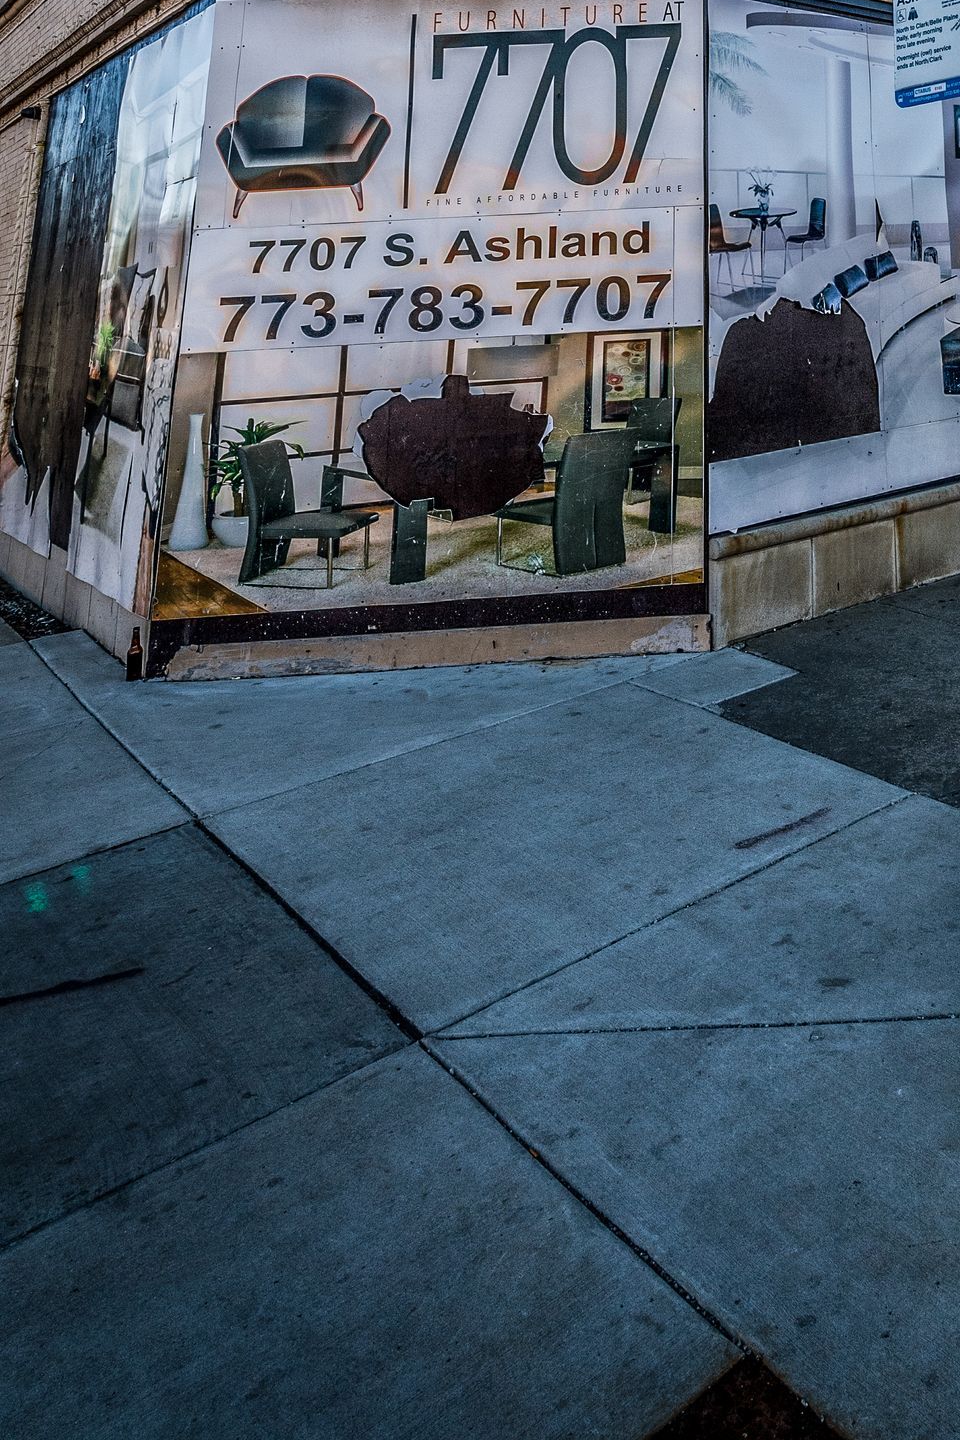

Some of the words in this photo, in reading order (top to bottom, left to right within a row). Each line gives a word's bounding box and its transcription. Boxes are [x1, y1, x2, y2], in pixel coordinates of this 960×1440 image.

[433, 2, 648, 33] FURNITURE
[662, 1, 685, 22] AT
[896, 26, 909, 34] North
[943, 14, 958, 22] Plaine
[916, 37, 935, 45] evening
[922, 26, 942, 35] morning
[896, 52, 919, 62] Overnight
[934, 45, 951, 53] service
[431, 22, 682, 195] 7707
[426, 197, 462, 207] FINE
[476, 190, 580, 204] AFFORDABLE
[593, 184, 683, 198] FURNITURE
[248, 234, 367, 275] 7707
[382, 231, 429, 267] S.
[443, 220, 651, 265] Ashland
[218, 273, 673, 343] 773-783-7707
